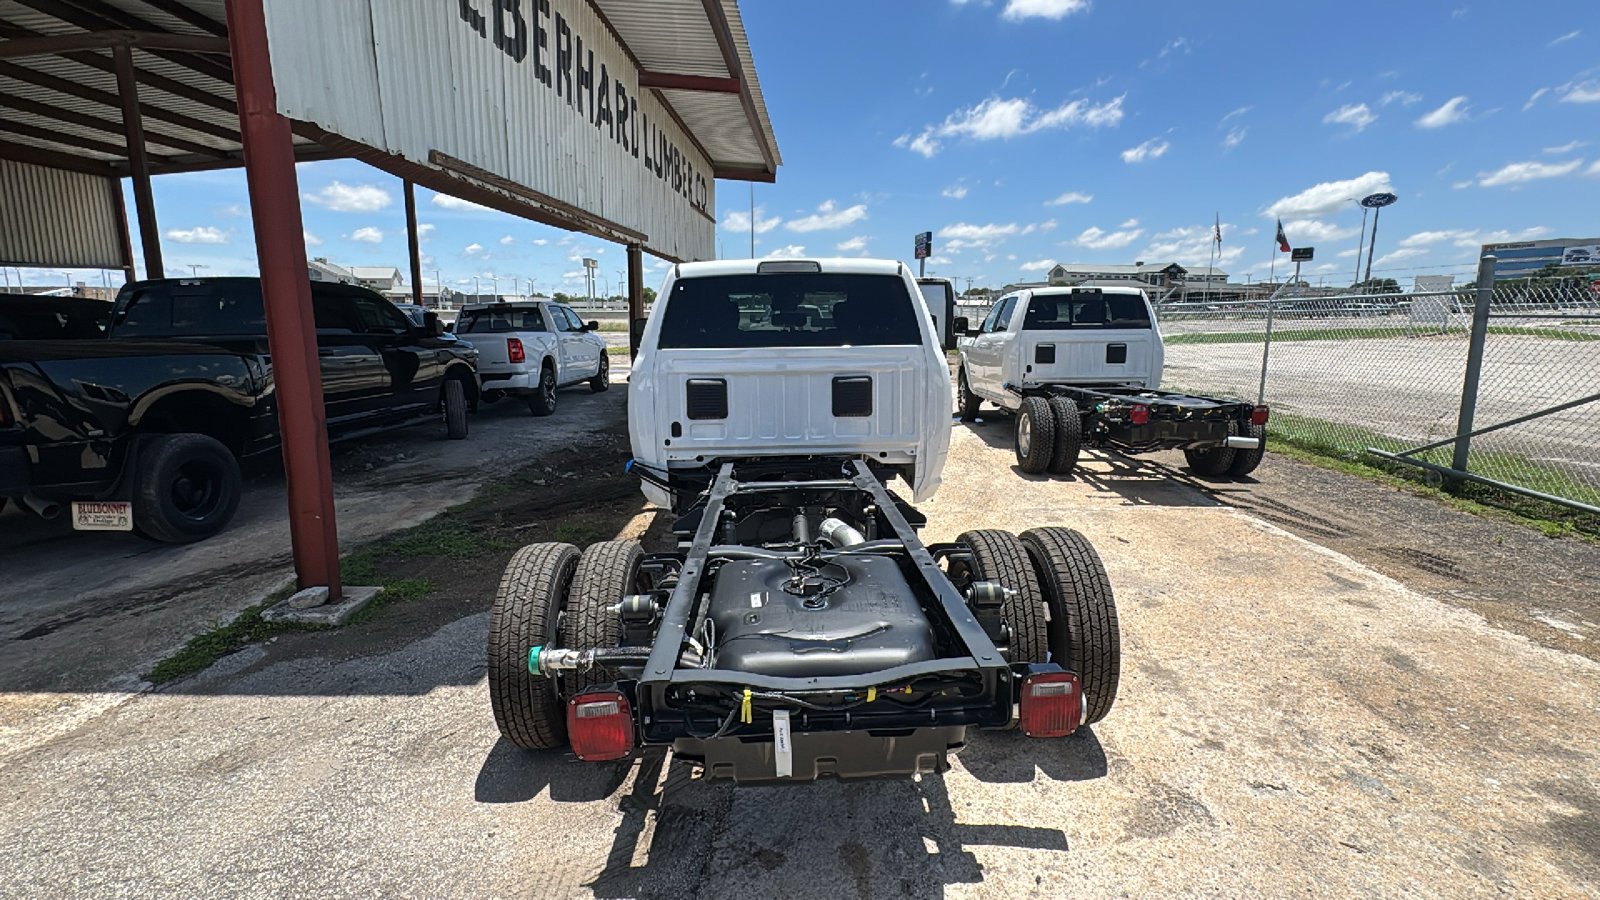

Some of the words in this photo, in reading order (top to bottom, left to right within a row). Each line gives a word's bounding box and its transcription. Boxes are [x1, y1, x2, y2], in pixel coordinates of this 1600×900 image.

[459, 0, 638, 159] BERHARD
[643, 113, 692, 203] LUMBER
[1367, 195, 1389, 206] Ford
[78, 503, 127, 514] BLUEBONNET
